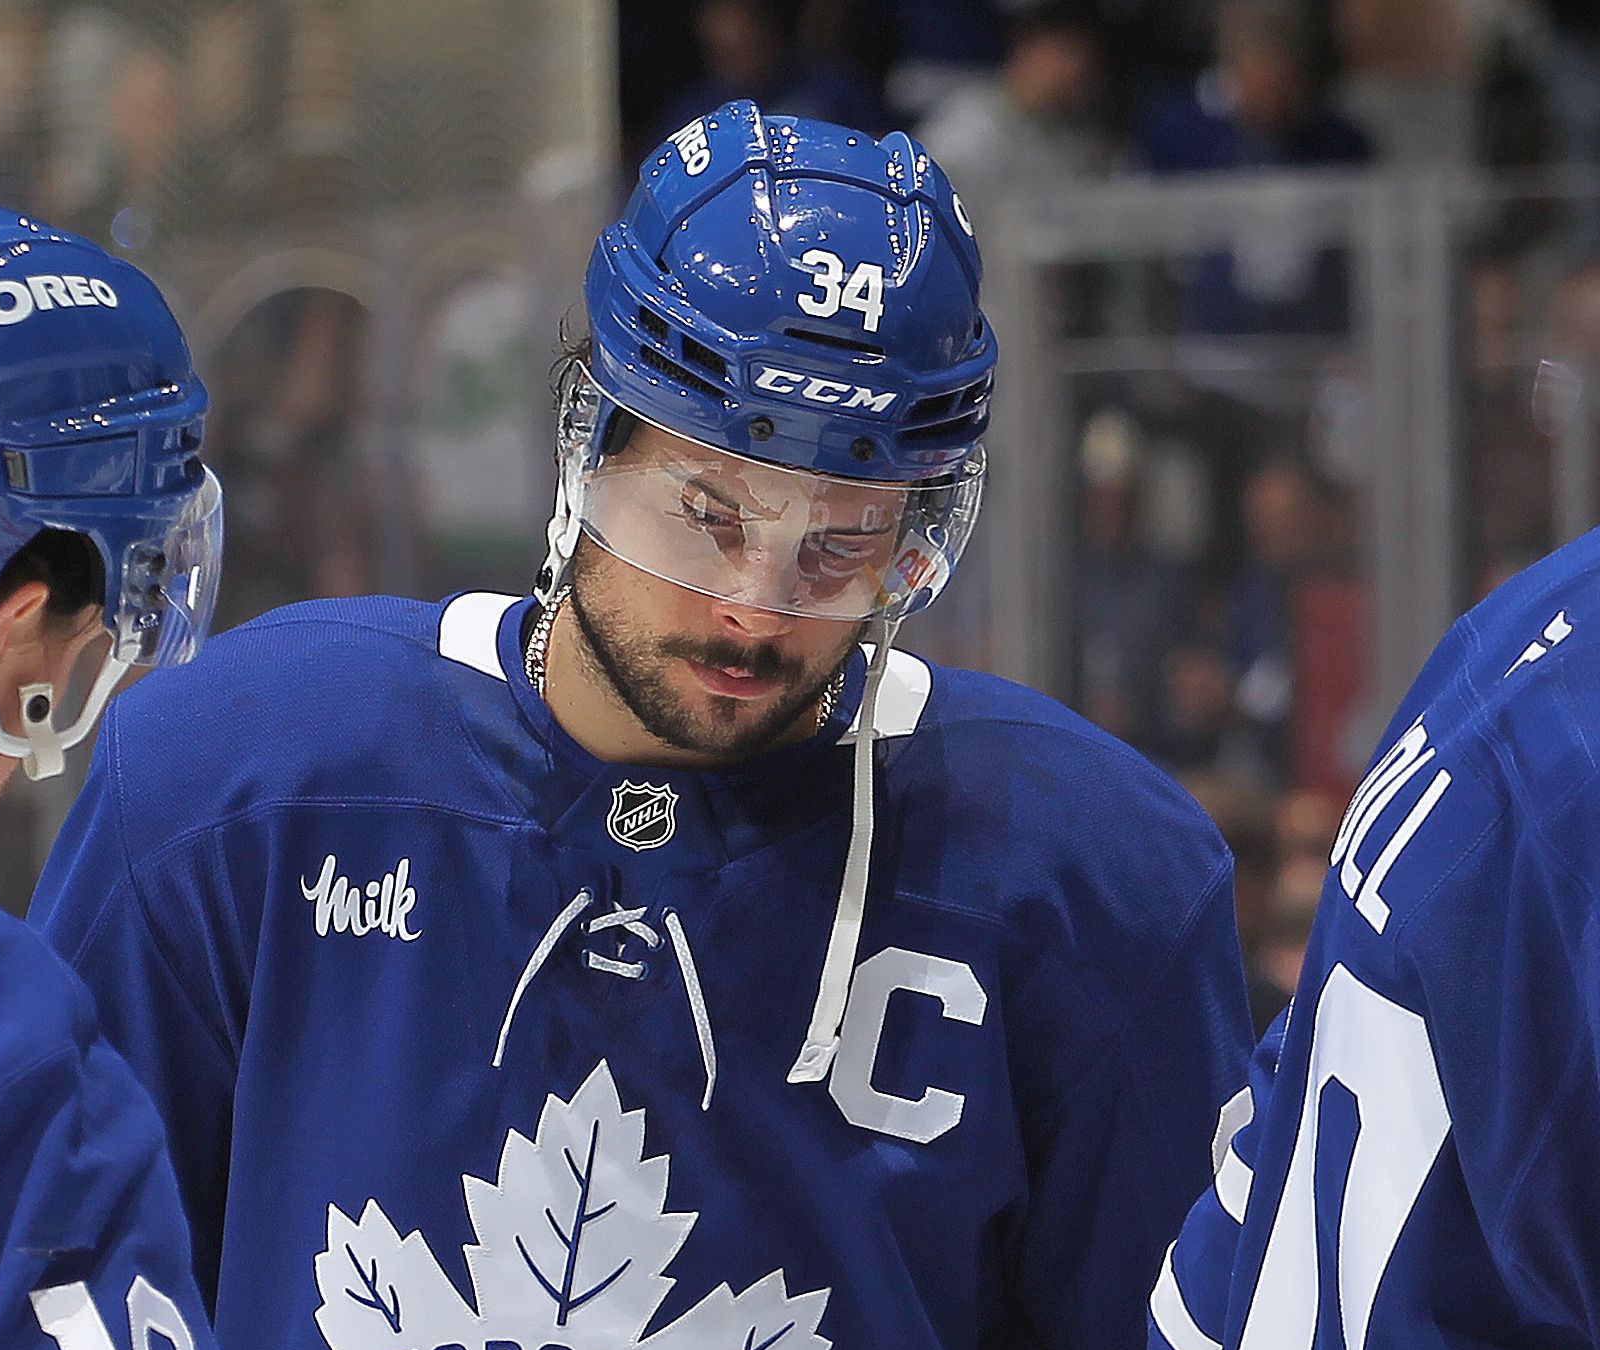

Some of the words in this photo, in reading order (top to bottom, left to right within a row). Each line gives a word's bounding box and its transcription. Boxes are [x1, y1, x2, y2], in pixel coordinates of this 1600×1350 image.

[798, 249, 884, 332] 34
[754, 366, 897, 413] CCM
[623, 802, 663, 833] NHL
[1329, 712, 1452, 935] OLL
[301, 854, 422, 941] Milk
[829, 946, 988, 1144] C
